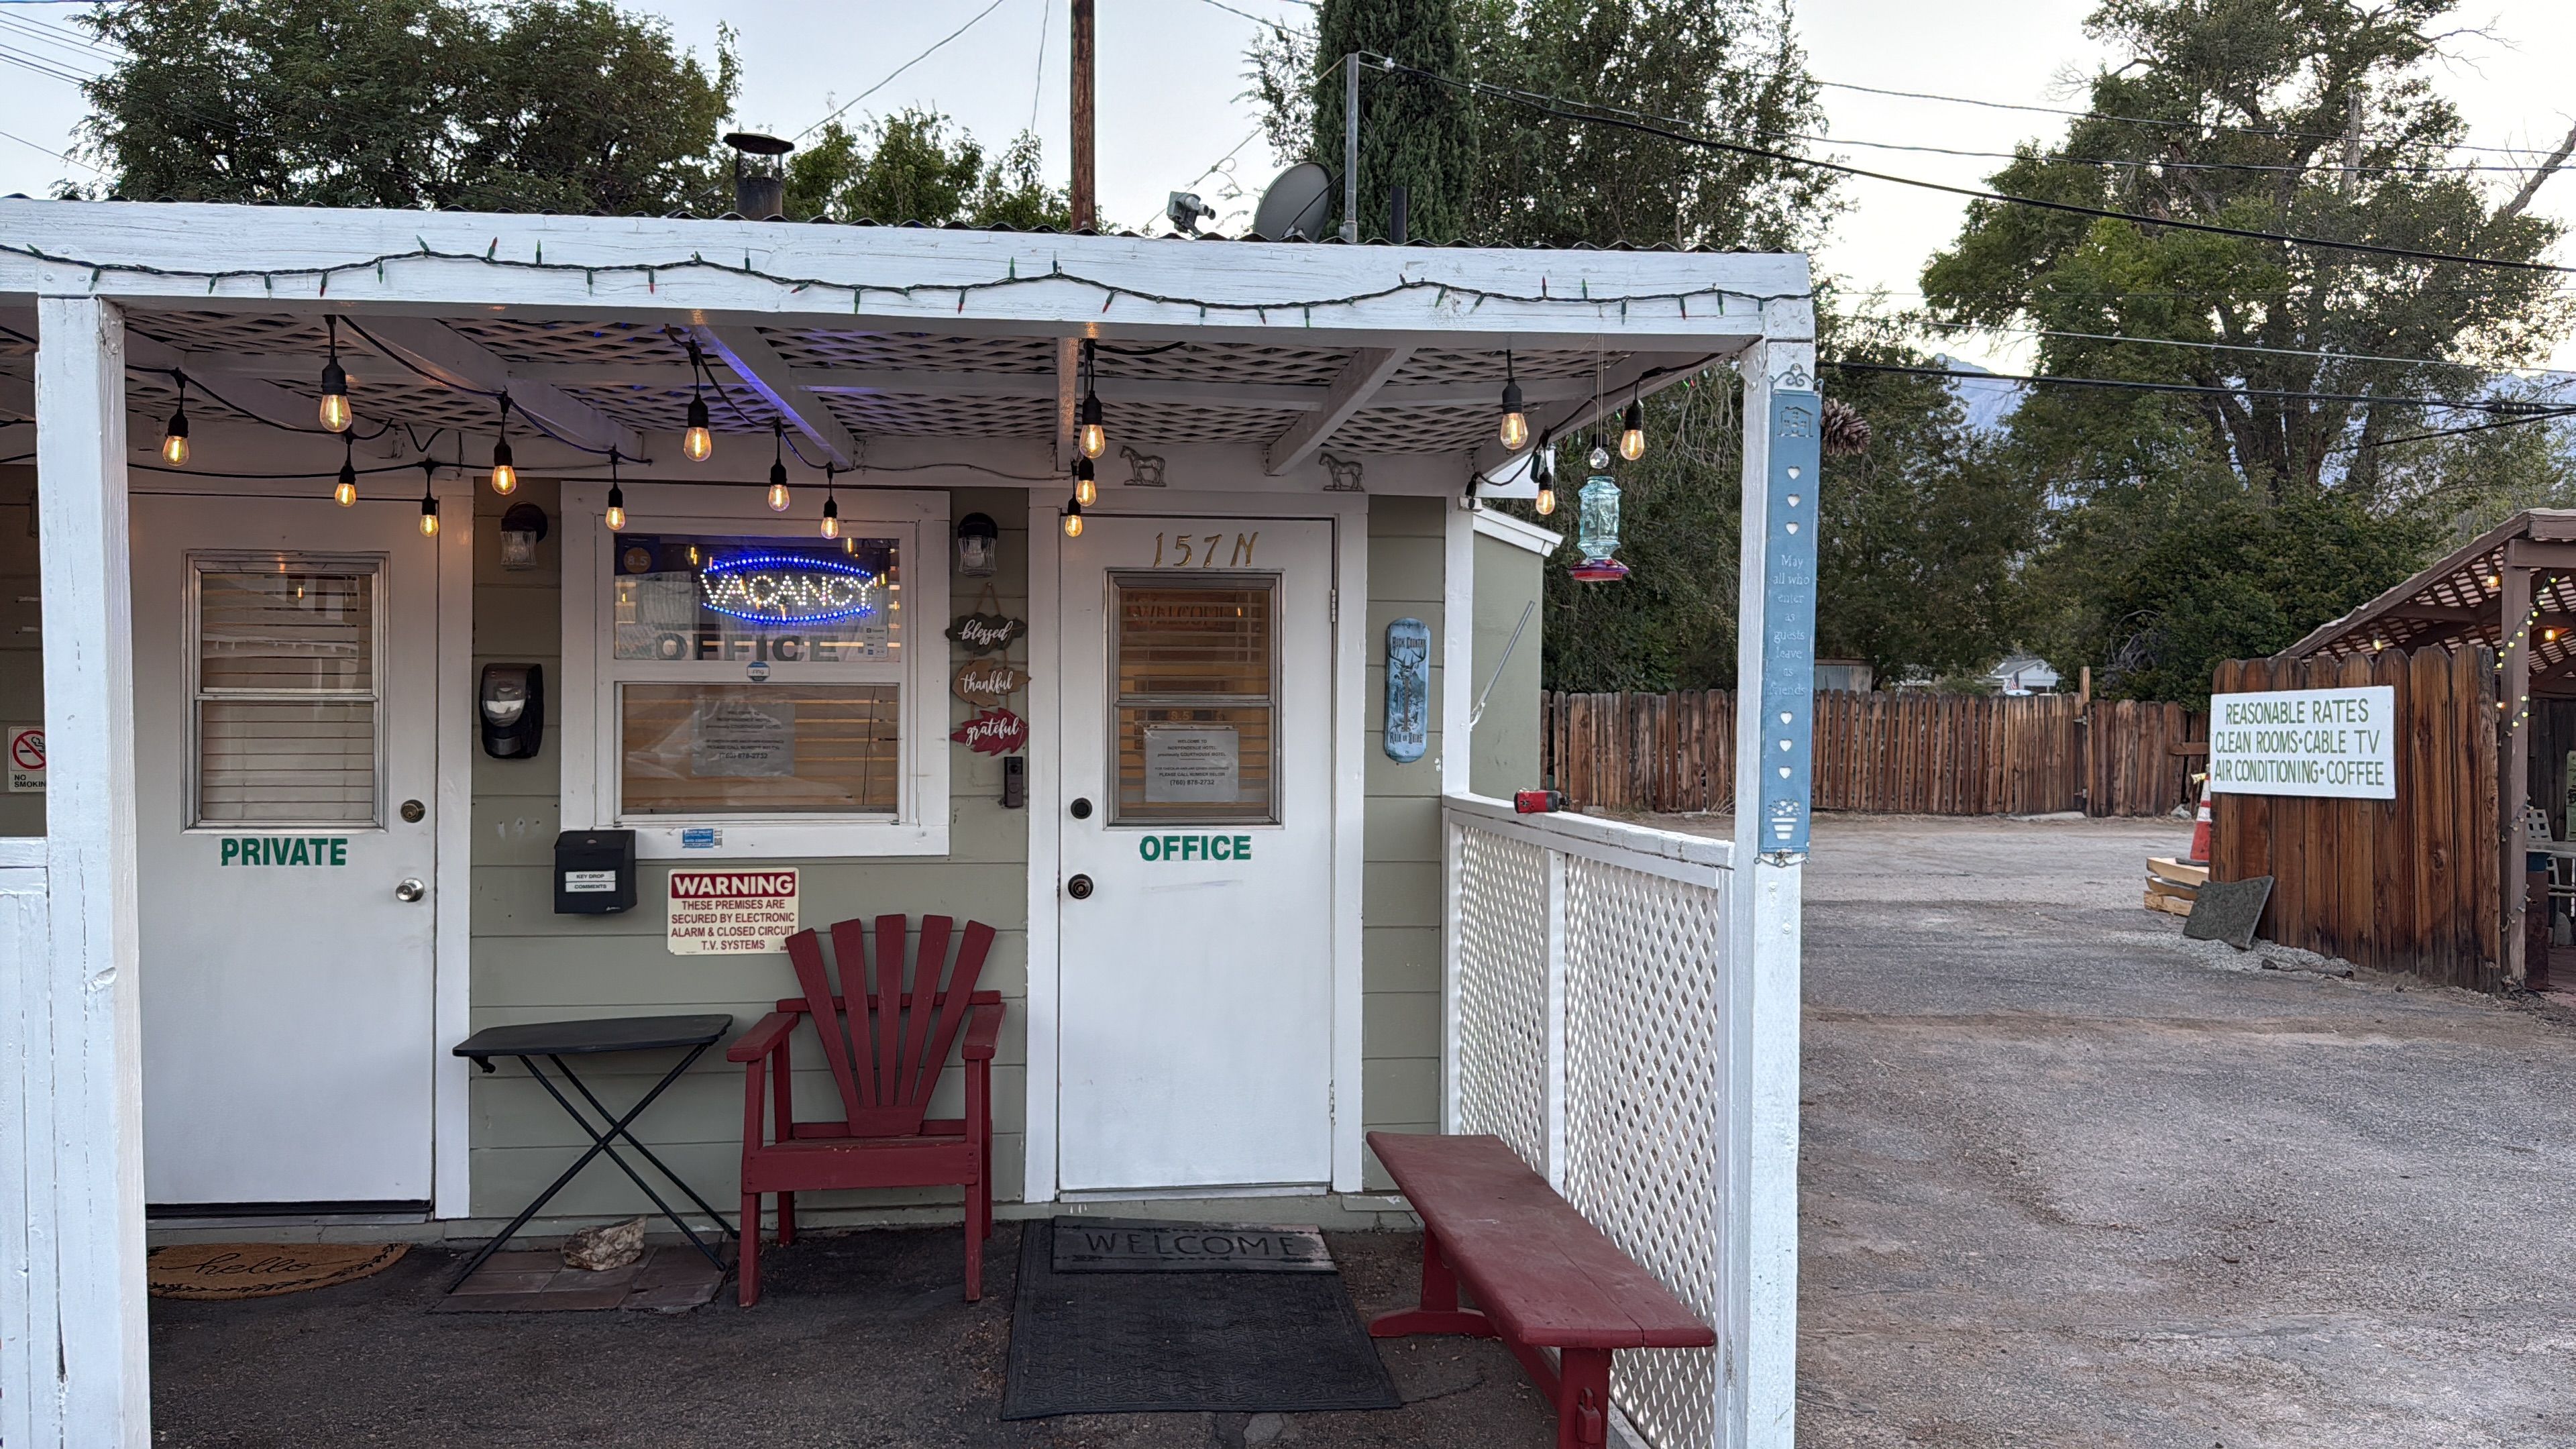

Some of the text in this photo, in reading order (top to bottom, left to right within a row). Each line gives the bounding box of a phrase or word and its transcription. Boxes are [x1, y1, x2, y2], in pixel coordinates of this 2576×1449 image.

[1781, 554, 1803, 569] May
[1773, 573, 1810, 585] all who
[700, 574, 877, 606] VACANCY
[1778, 594, 1805, 604] enter
[1785, 613, 1795, 622] as
[958, 619, 1014, 645] blessed
[1774, 631, 1805, 644] guests
[655, 633, 839, 661] OFFICE
[1776, 647, 1803, 659] leave
[961, 671, 1014, 694] thankful
[1783, 667, 1793, 677] as
[1769, 682, 1805, 696] friends
[2225, 698, 2369, 725] REASONABLE RATES
[966, 717, 1020, 747] grateful
[2216, 731, 2251, 753] CLEAN
[2354, 729, 2380, 754] TV
[2214, 759, 2233, 782] AIR
[221, 838, 348, 866] PRIVATE
[1139, 835, 1252, 861] OFFICE
[674, 875, 794, 896] WARNING
[682, 899, 786, 910] THESE PREMISES ARE
[672, 912, 794, 924] SECURED BY ELECTRONIC
[671, 925, 795, 937] ALARM & CLOSED CIRCUIT
[702, 939, 765, 951] T.V. SYSTEMS
[1085, 1232, 1301, 1256] WELCOME
[161, 1252, 329, 1275] hello
